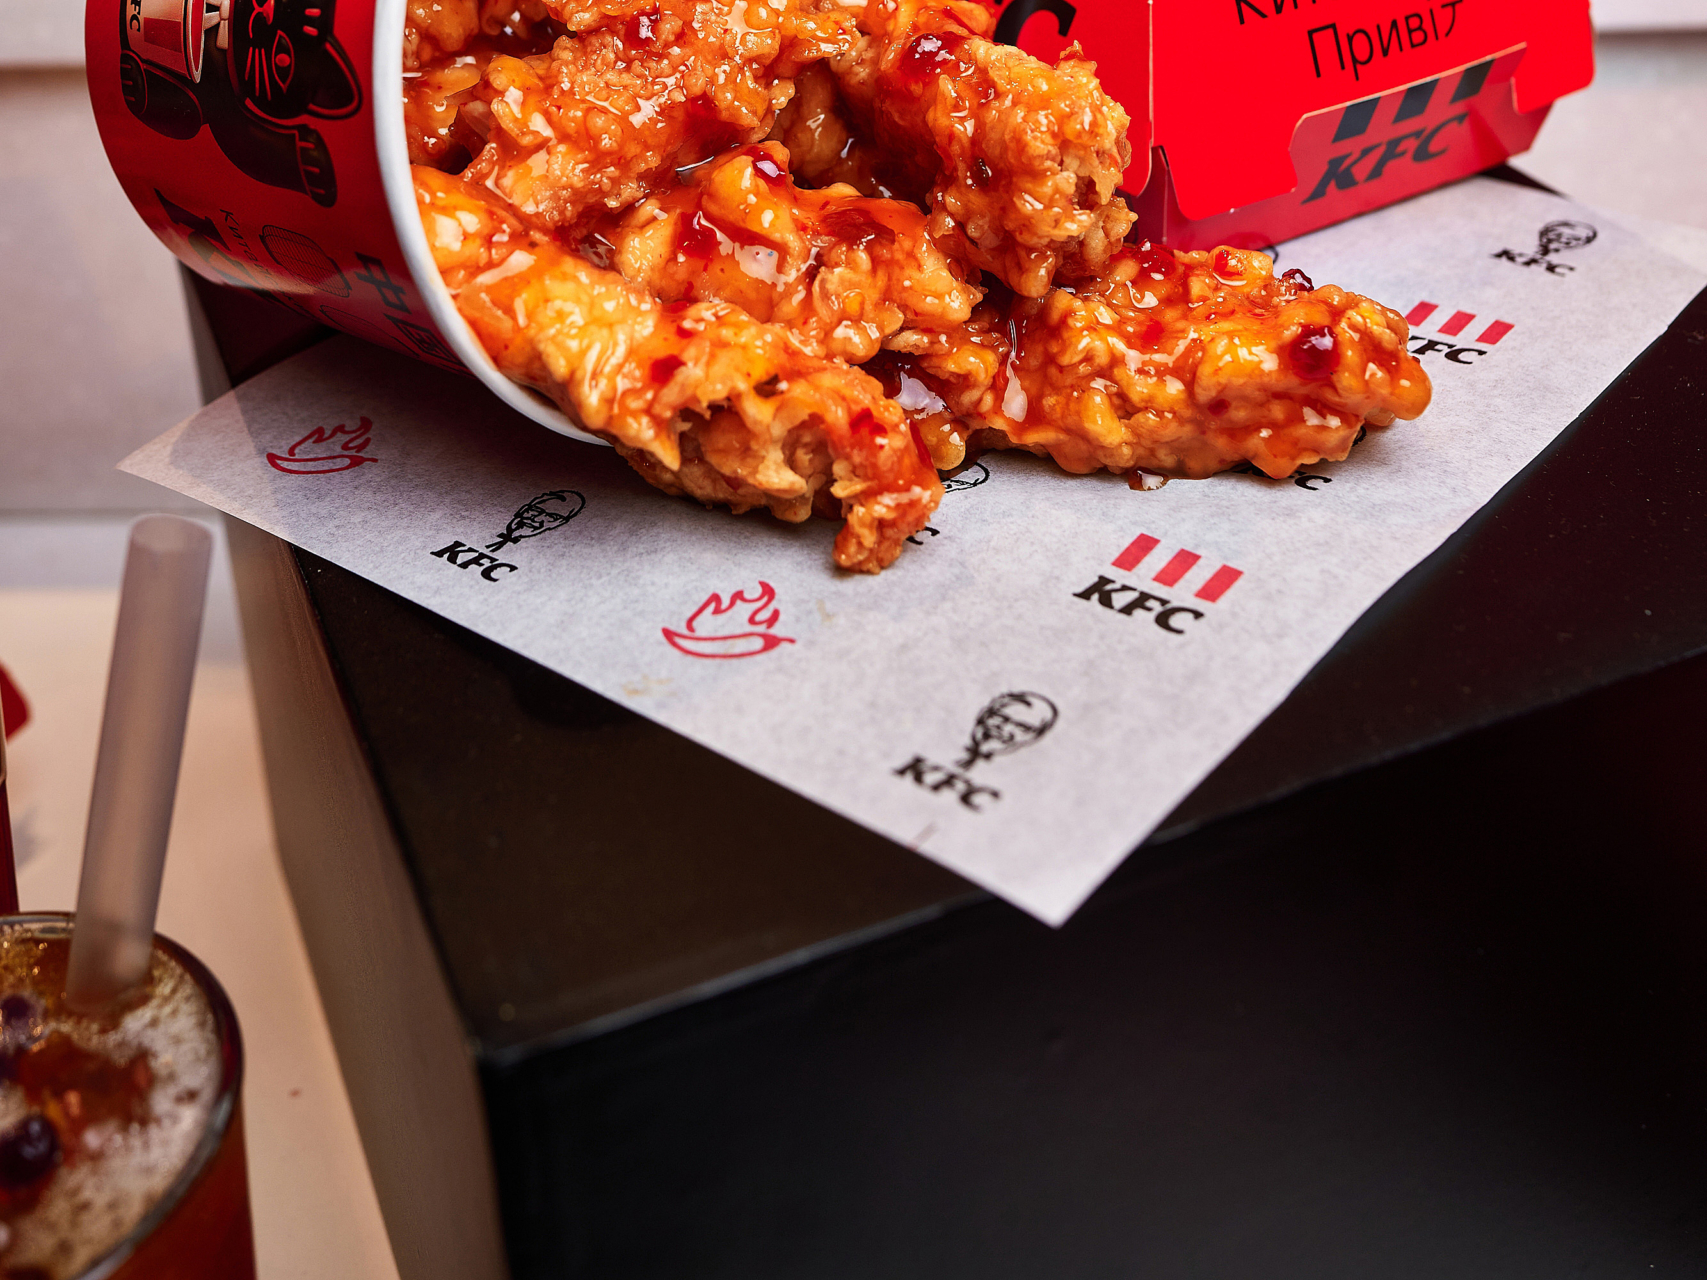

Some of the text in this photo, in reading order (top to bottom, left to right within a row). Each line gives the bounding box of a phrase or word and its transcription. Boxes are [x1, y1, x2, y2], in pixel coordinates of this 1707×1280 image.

[1307, 0, 1464, 80] Привіт
[1301, 111, 1469, 205] KFC
[1490, 247, 1575, 277] KFC
[1405, 335, 1488, 365] FC
[430, 540, 518, 583] KFC
[1071, 574, 1205, 636] KFC
[893, 754, 1002, 812] KFC
